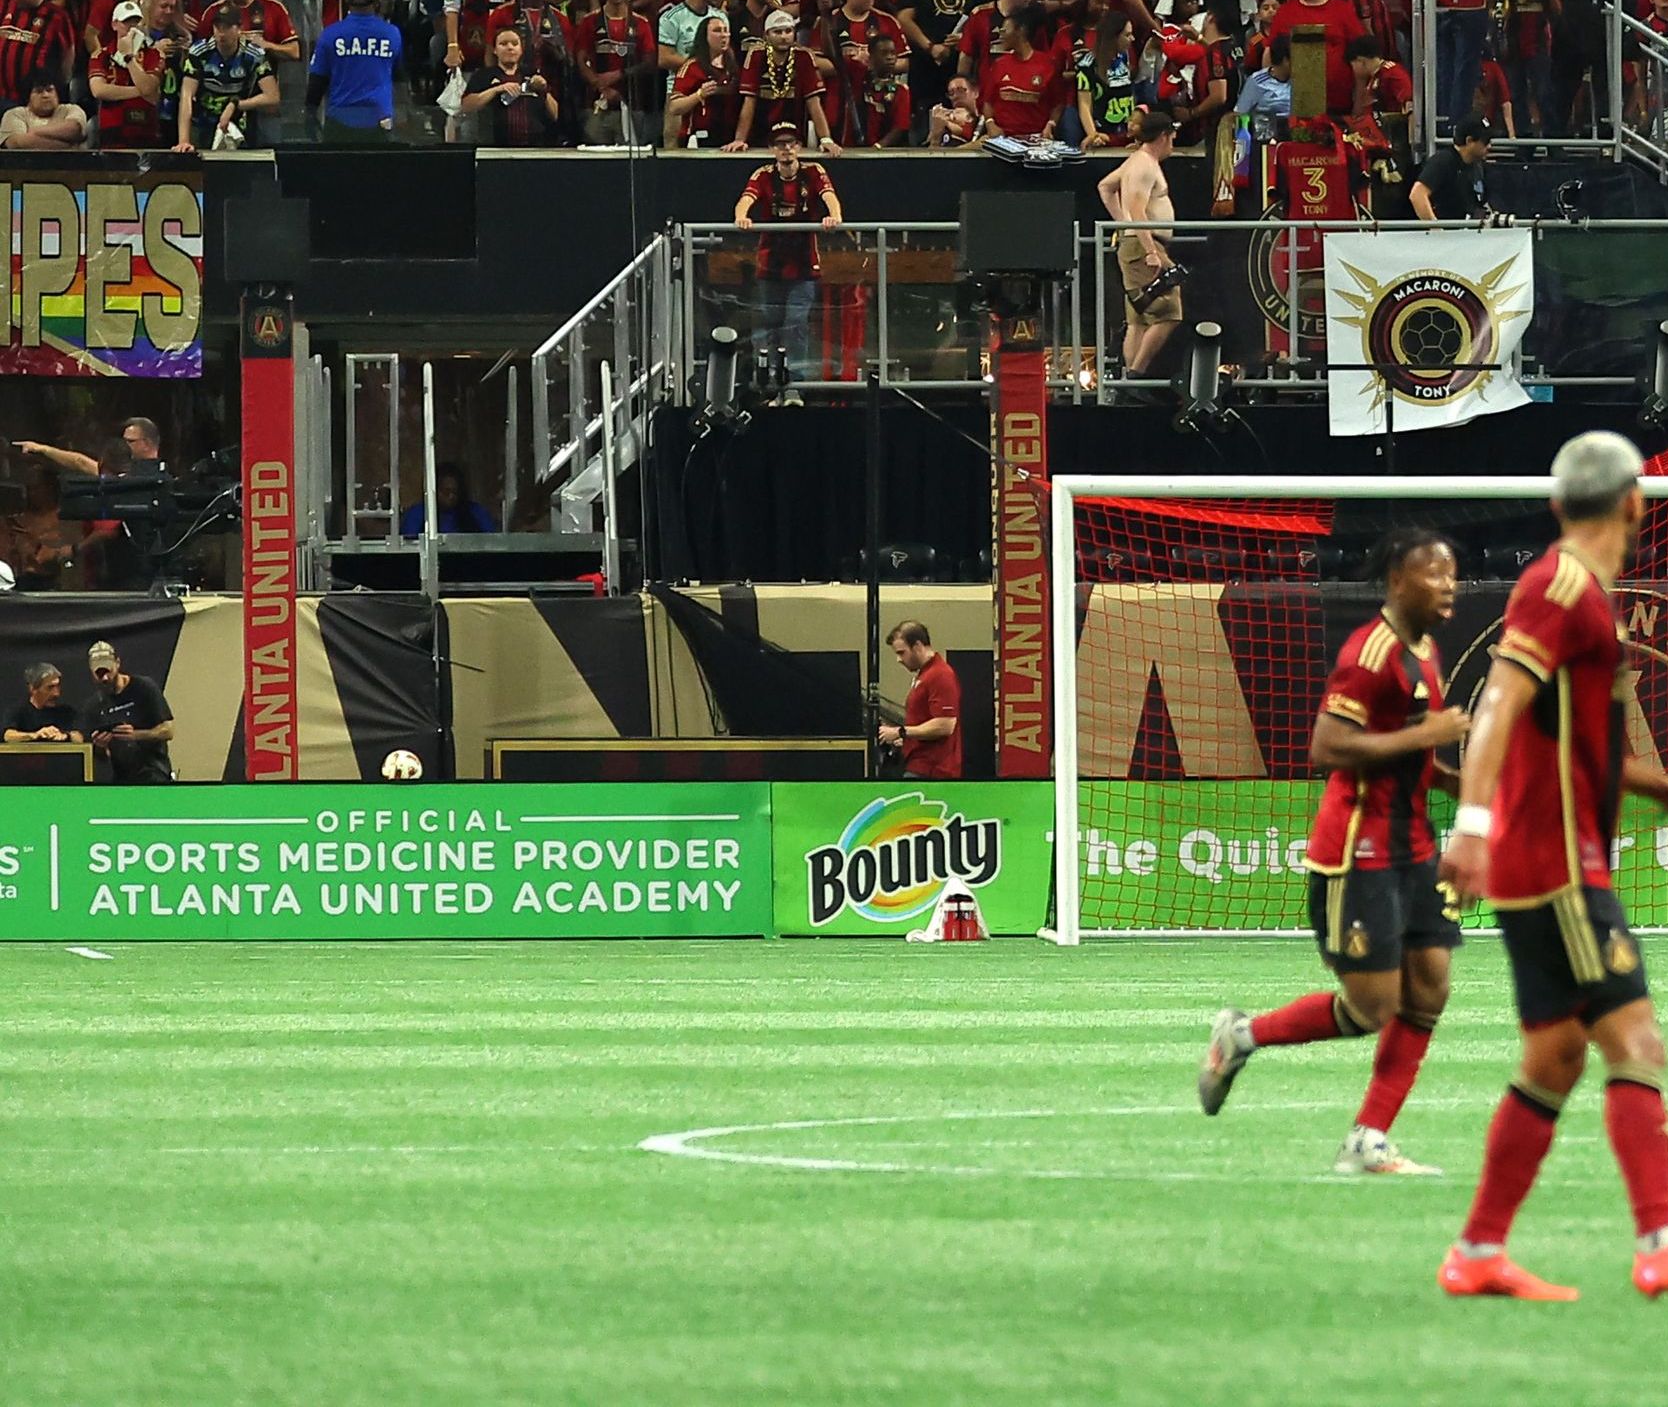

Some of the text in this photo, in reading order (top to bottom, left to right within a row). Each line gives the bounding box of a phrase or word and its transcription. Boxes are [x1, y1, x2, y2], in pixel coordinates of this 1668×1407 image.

[335, 37, 393, 58] S.A.F.E.
[1302, 168, 1328, 203] 3
[1303, 204, 1329, 216] TONY
[1393, 281, 1466, 302] MACARONI
[1414, 383, 1453, 399] TONY
[1003, 412, 1044, 754] ATLANTA UNITED
[251, 460, 292, 781] LANTA UNITED
[316, 809, 512, 833] OFFICIAL
[89, 839, 740, 873] SPORTS MEDICINE PROVIDER
[1046, 826, 1156, 877] he
[808, 815, 998, 924] Bounty
[89, 880, 742, 916] ATLANTA UNITED ACADEMY
